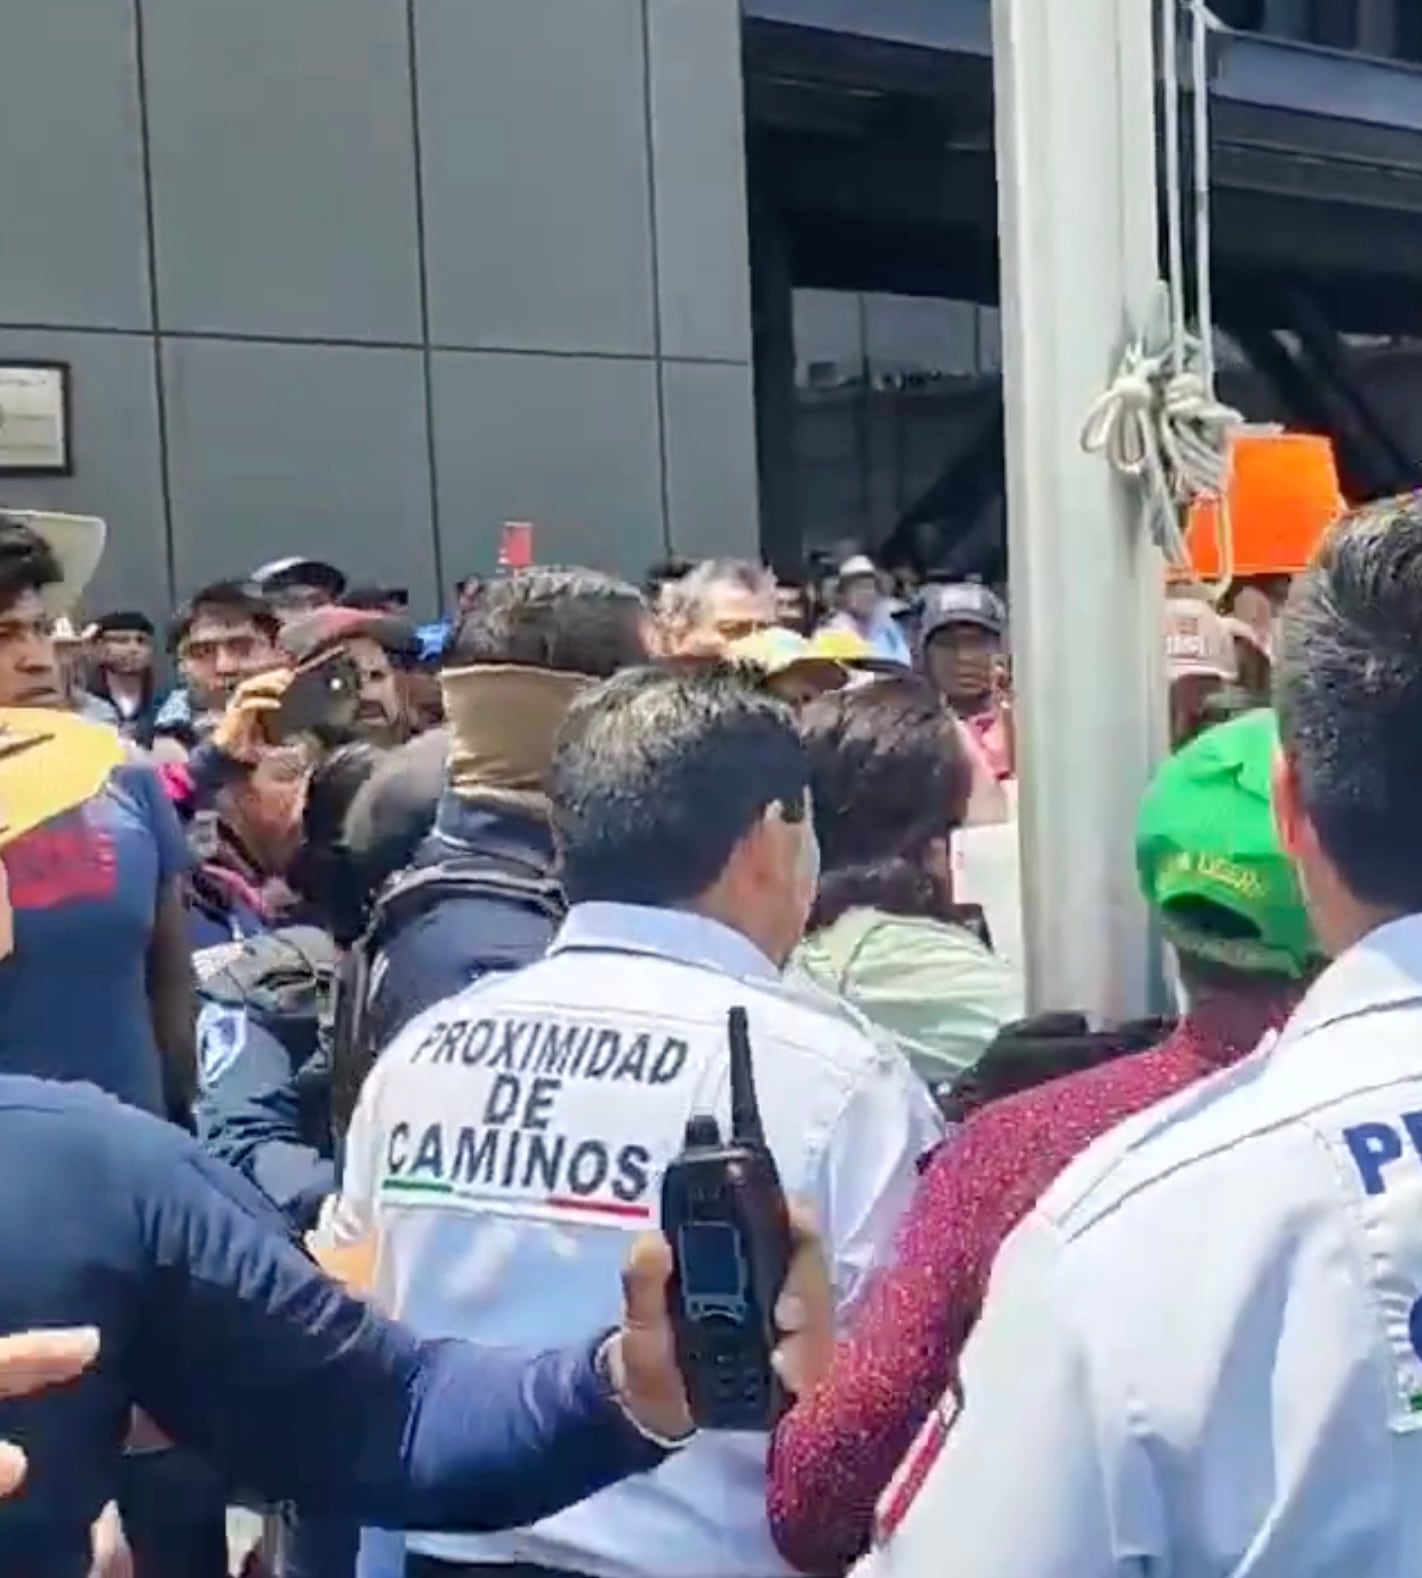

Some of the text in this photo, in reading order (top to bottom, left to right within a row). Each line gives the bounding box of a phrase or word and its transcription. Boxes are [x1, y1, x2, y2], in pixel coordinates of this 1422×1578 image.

[410, 1018, 689, 1085] PROXIMIDAD
[483, 1071, 562, 1129] DE
[387, 1121, 650, 1202] CAMINOS
